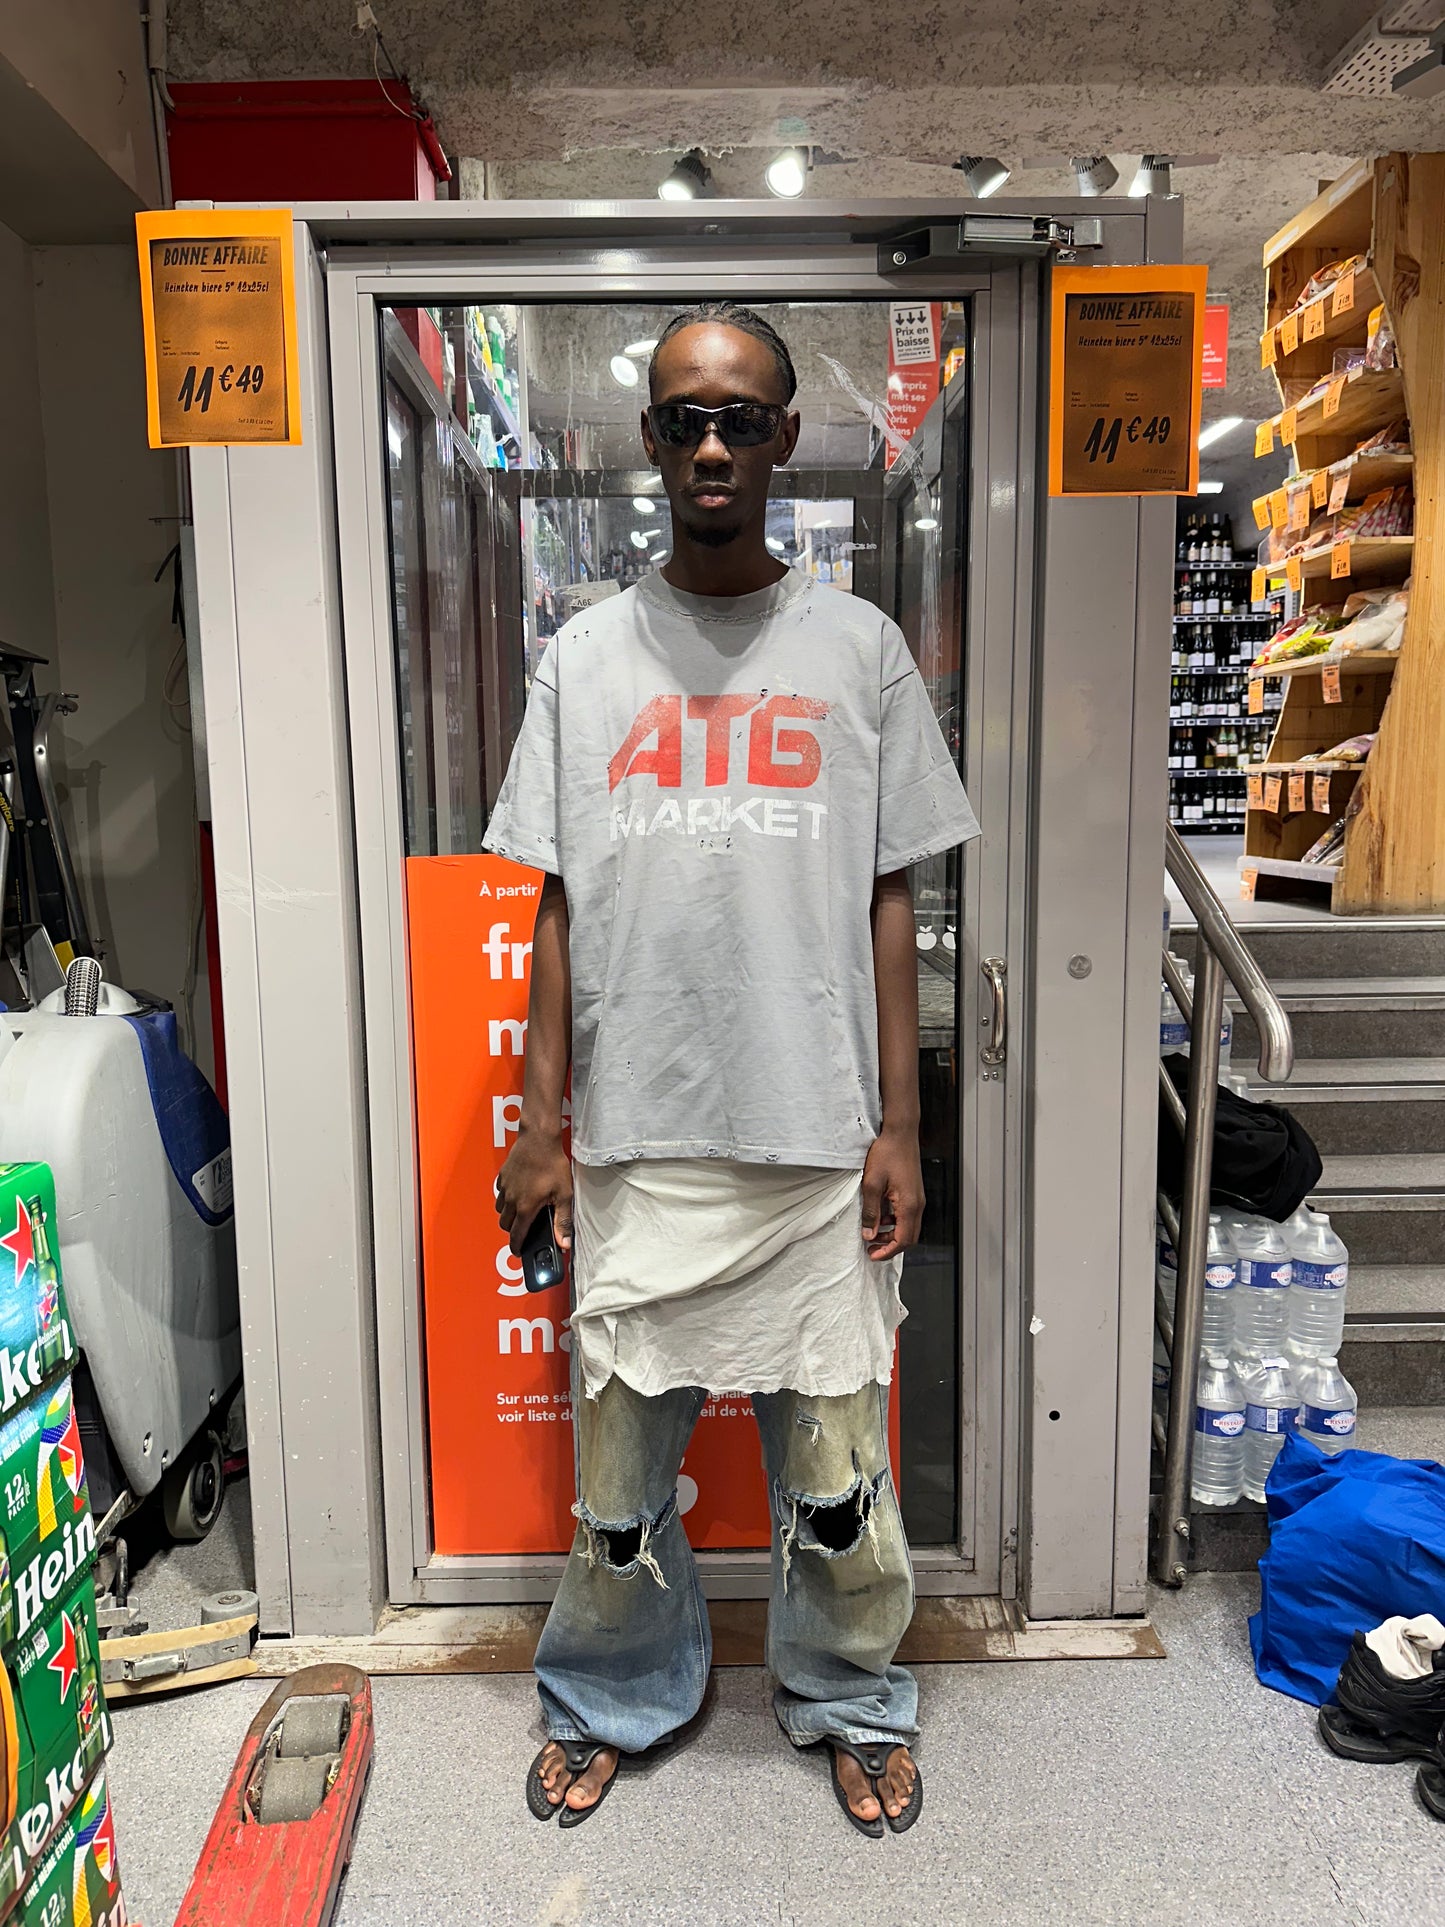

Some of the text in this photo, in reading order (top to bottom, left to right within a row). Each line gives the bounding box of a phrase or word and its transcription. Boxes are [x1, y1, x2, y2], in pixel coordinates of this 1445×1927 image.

[163, 246, 209, 267] BONNE
[164, 281, 199, 293] Heineken
[201, 281, 222, 293] biere
[1079, 302, 1125, 320] BONNE
[895, 326, 929, 337] Prix en
[896, 337, 930, 348] baisse
[1078, 335, 1113, 347] Heineken
[1115, 335, 1136, 347] biere
[911, 394, 926, 402] ses
[891, 403, 917, 414] petits
[608, 694, 836, 795] ATG
[609, 797, 829, 842] MARKET
[479, 881, 538, 900] À partir
[497, 1393, 520, 1405] Sur
[523, 1394, 549, 1404] une
[497, 1410, 524, 1422] voir
[528, 1409, 557, 1422] liste
[720, 1404, 738, 1416] de
[4, 1473, 25, 1510] 12
[8, 1498, 26, 1521] PACK
[16, 1646, 32, 1672] 12
[23, 1880, 40, 1908] UNE
